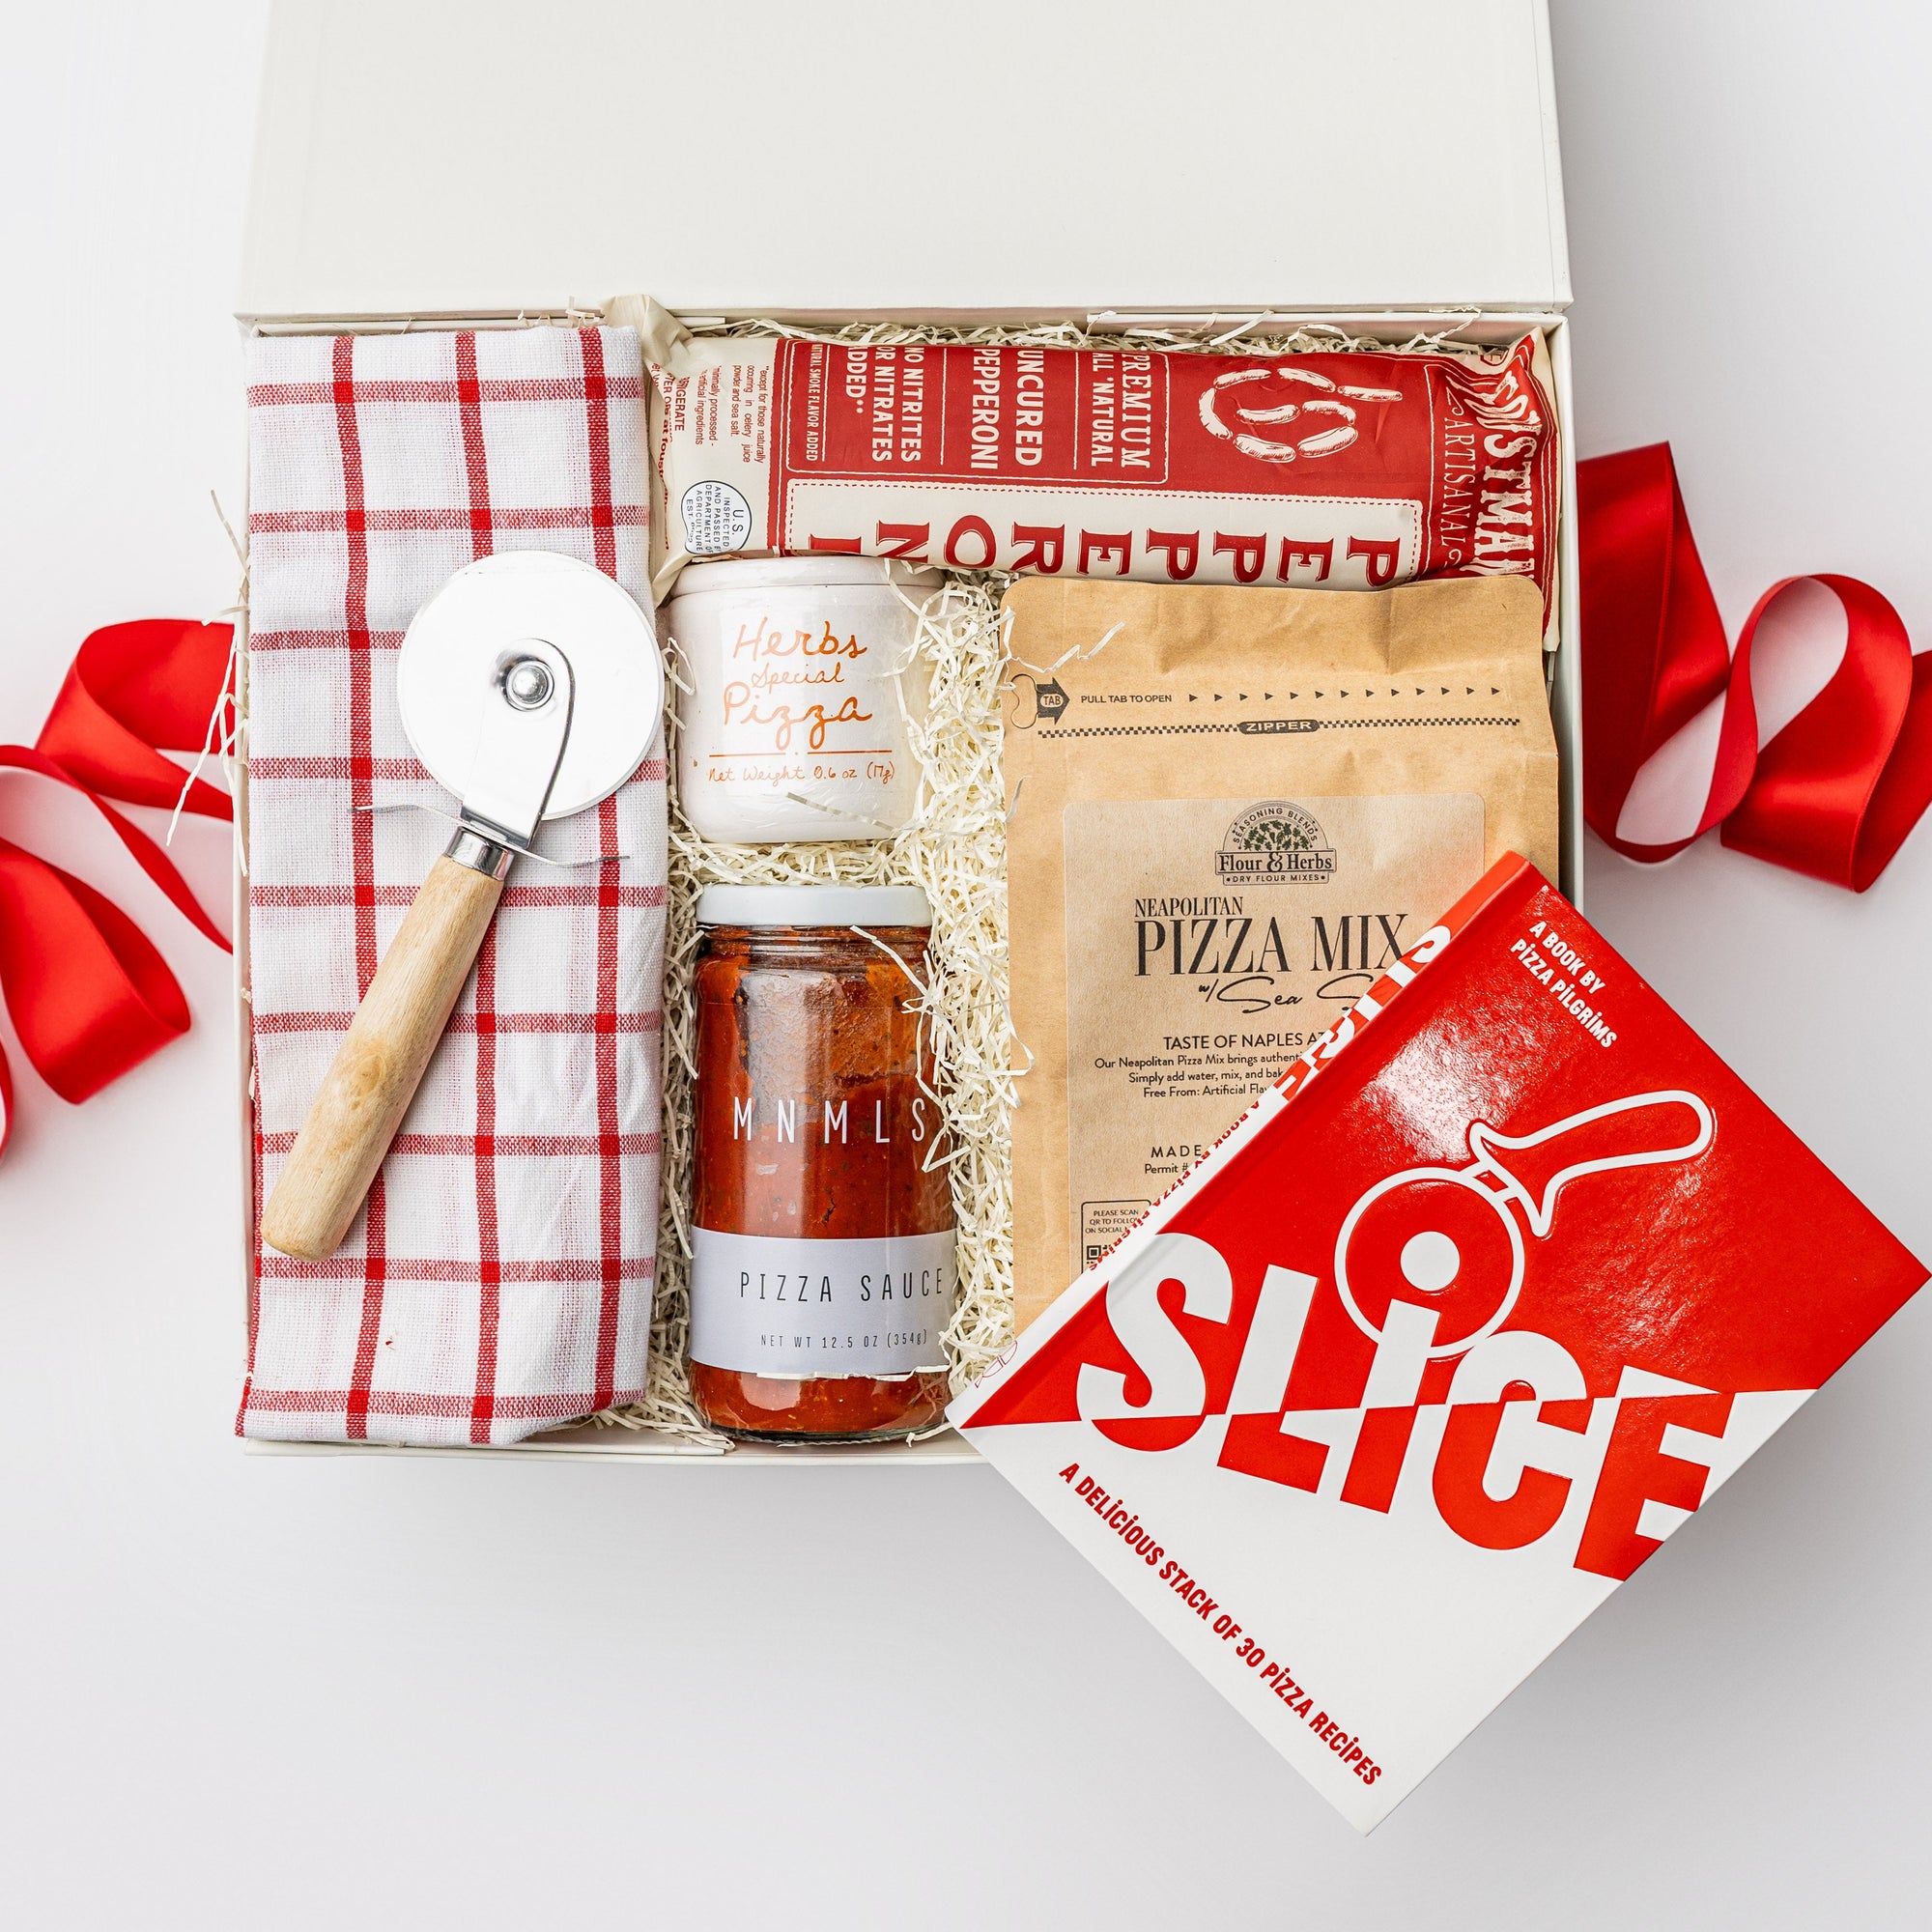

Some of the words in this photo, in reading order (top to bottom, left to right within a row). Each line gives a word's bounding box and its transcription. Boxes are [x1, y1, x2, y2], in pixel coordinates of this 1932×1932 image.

[875, 347, 896, 360] OR
[904, 347, 924, 363] NO
[1092, 353, 1114, 372] ALL
[732, 388, 742, 402] and
[809, 368, 821, 394] SMOKE
[731, 405, 740, 418] sea
[758, 392, 769, 404] for
[808, 395, 820, 428] FLAVOR
[970, 349, 1001, 469] PEPPERONI
[1014, 350, 1044, 467] UNCURED
[1120, 354, 1152, 469] PREMIUM
[695, 400, 706, 445] ingredients
[709, 399, 718, 440] processed
[742, 413, 753, 438] celery
[757, 406, 768, 427] those
[871, 366, 895, 462] NITRATES
[900, 368, 924, 462] NITRITES
[730, 422, 740, 438] salt.
[741, 443, 753, 463] juice
[754, 430, 767, 464] naturally
[806, 430, 819, 461] ADDED
[1440, 416, 1476, 547] ARTISANAL
[704, 484, 713, 543] DEPARTMENT
[713, 508, 722, 542] PASSED
[722, 497, 730, 547] INSPECTED
[732, 616, 867, 662] Herbs
[752, 662, 845, 695] Special
[1042, 695, 1062, 706] TAB
[1080, 695, 1107, 703] PULL
[1108, 695, 1128, 703] TAB
[1130, 695, 1143, 703] TO
[1145, 695, 1172, 703] OPEN
[724, 681, 873, 751] Pizza
[1246, 721, 1312, 732] ZIPPER
[708, 766, 731, 782] Net
[744, 766, 805, 787] Weight
[813, 765, 837, 780] 0.6
[841, 769, 858, 779] oz
[1233, 807, 1284, 843] SEASONING
[1288, 810, 1318, 841] BLENDS
[1219, 854, 1263, 871] Flour
[1266, 852, 1283, 872] &
[1287, 853, 1332, 869] Herbs
[1134, 896, 1243, 917] NEAPOLITAN
[1134, 916, 1292, 977] PIZZA
[1310, 914, 1408, 972] MIX
[1528, 921, 1547, 939] A
[1542, 931, 1586, 977] BOOK
[1578, 970, 1605, 994] BY
[1216, 975, 1302, 1014] Sea
[1163, 1036, 1209, 1050] TASTE
[1213, 1035, 1237, 1049] OF
[1242, 1033, 1303, 1048] NAPLES
[1094, 1058, 1116, 1068] Our
[1119, 1056, 1175, 1069] Neapolitan
[1178, 1055, 1203, 1065] Pizza
[1206, 1054, 1225, 1065] Mix
[1227, 1053, 1258, 1066] brings
[1128, 1071, 1163, 1085] Simply
[1166, 1070, 1185, 1082] add
[1187, 1070, 1218, 1082] water,
[1221, 1069, 1242, 1081] mix,
[1245, 1067, 1263, 1079] and
[1144, 1087, 1167, 1097] Free
[1170, 1086, 1200, 1096] From:
[1202, 1083, 1246, 1095] Artificial
[733, 1096, 925, 1145] MNMLS
[1151, 1145, 1203, 1158] MADE
[1144, 1164, 1179, 1175] Permit
[740, 1271, 832, 1302] PIZZA
[860, 1267, 943, 1302] SAUCE
[760, 1334, 784, 1347] NET
[793, 1336, 811, 1349] WT
[822, 1336, 853, 1349] 12.5
[864, 1335, 878, 1348] OZ
[887, 1328, 927, 1349] (354g)
[1059, 1463, 1080, 1484] A
[1159, 1560, 1219, 1621] STACK
[1212, 1614, 1243, 1641] OF
[1236, 1637, 1265, 1667] 30
